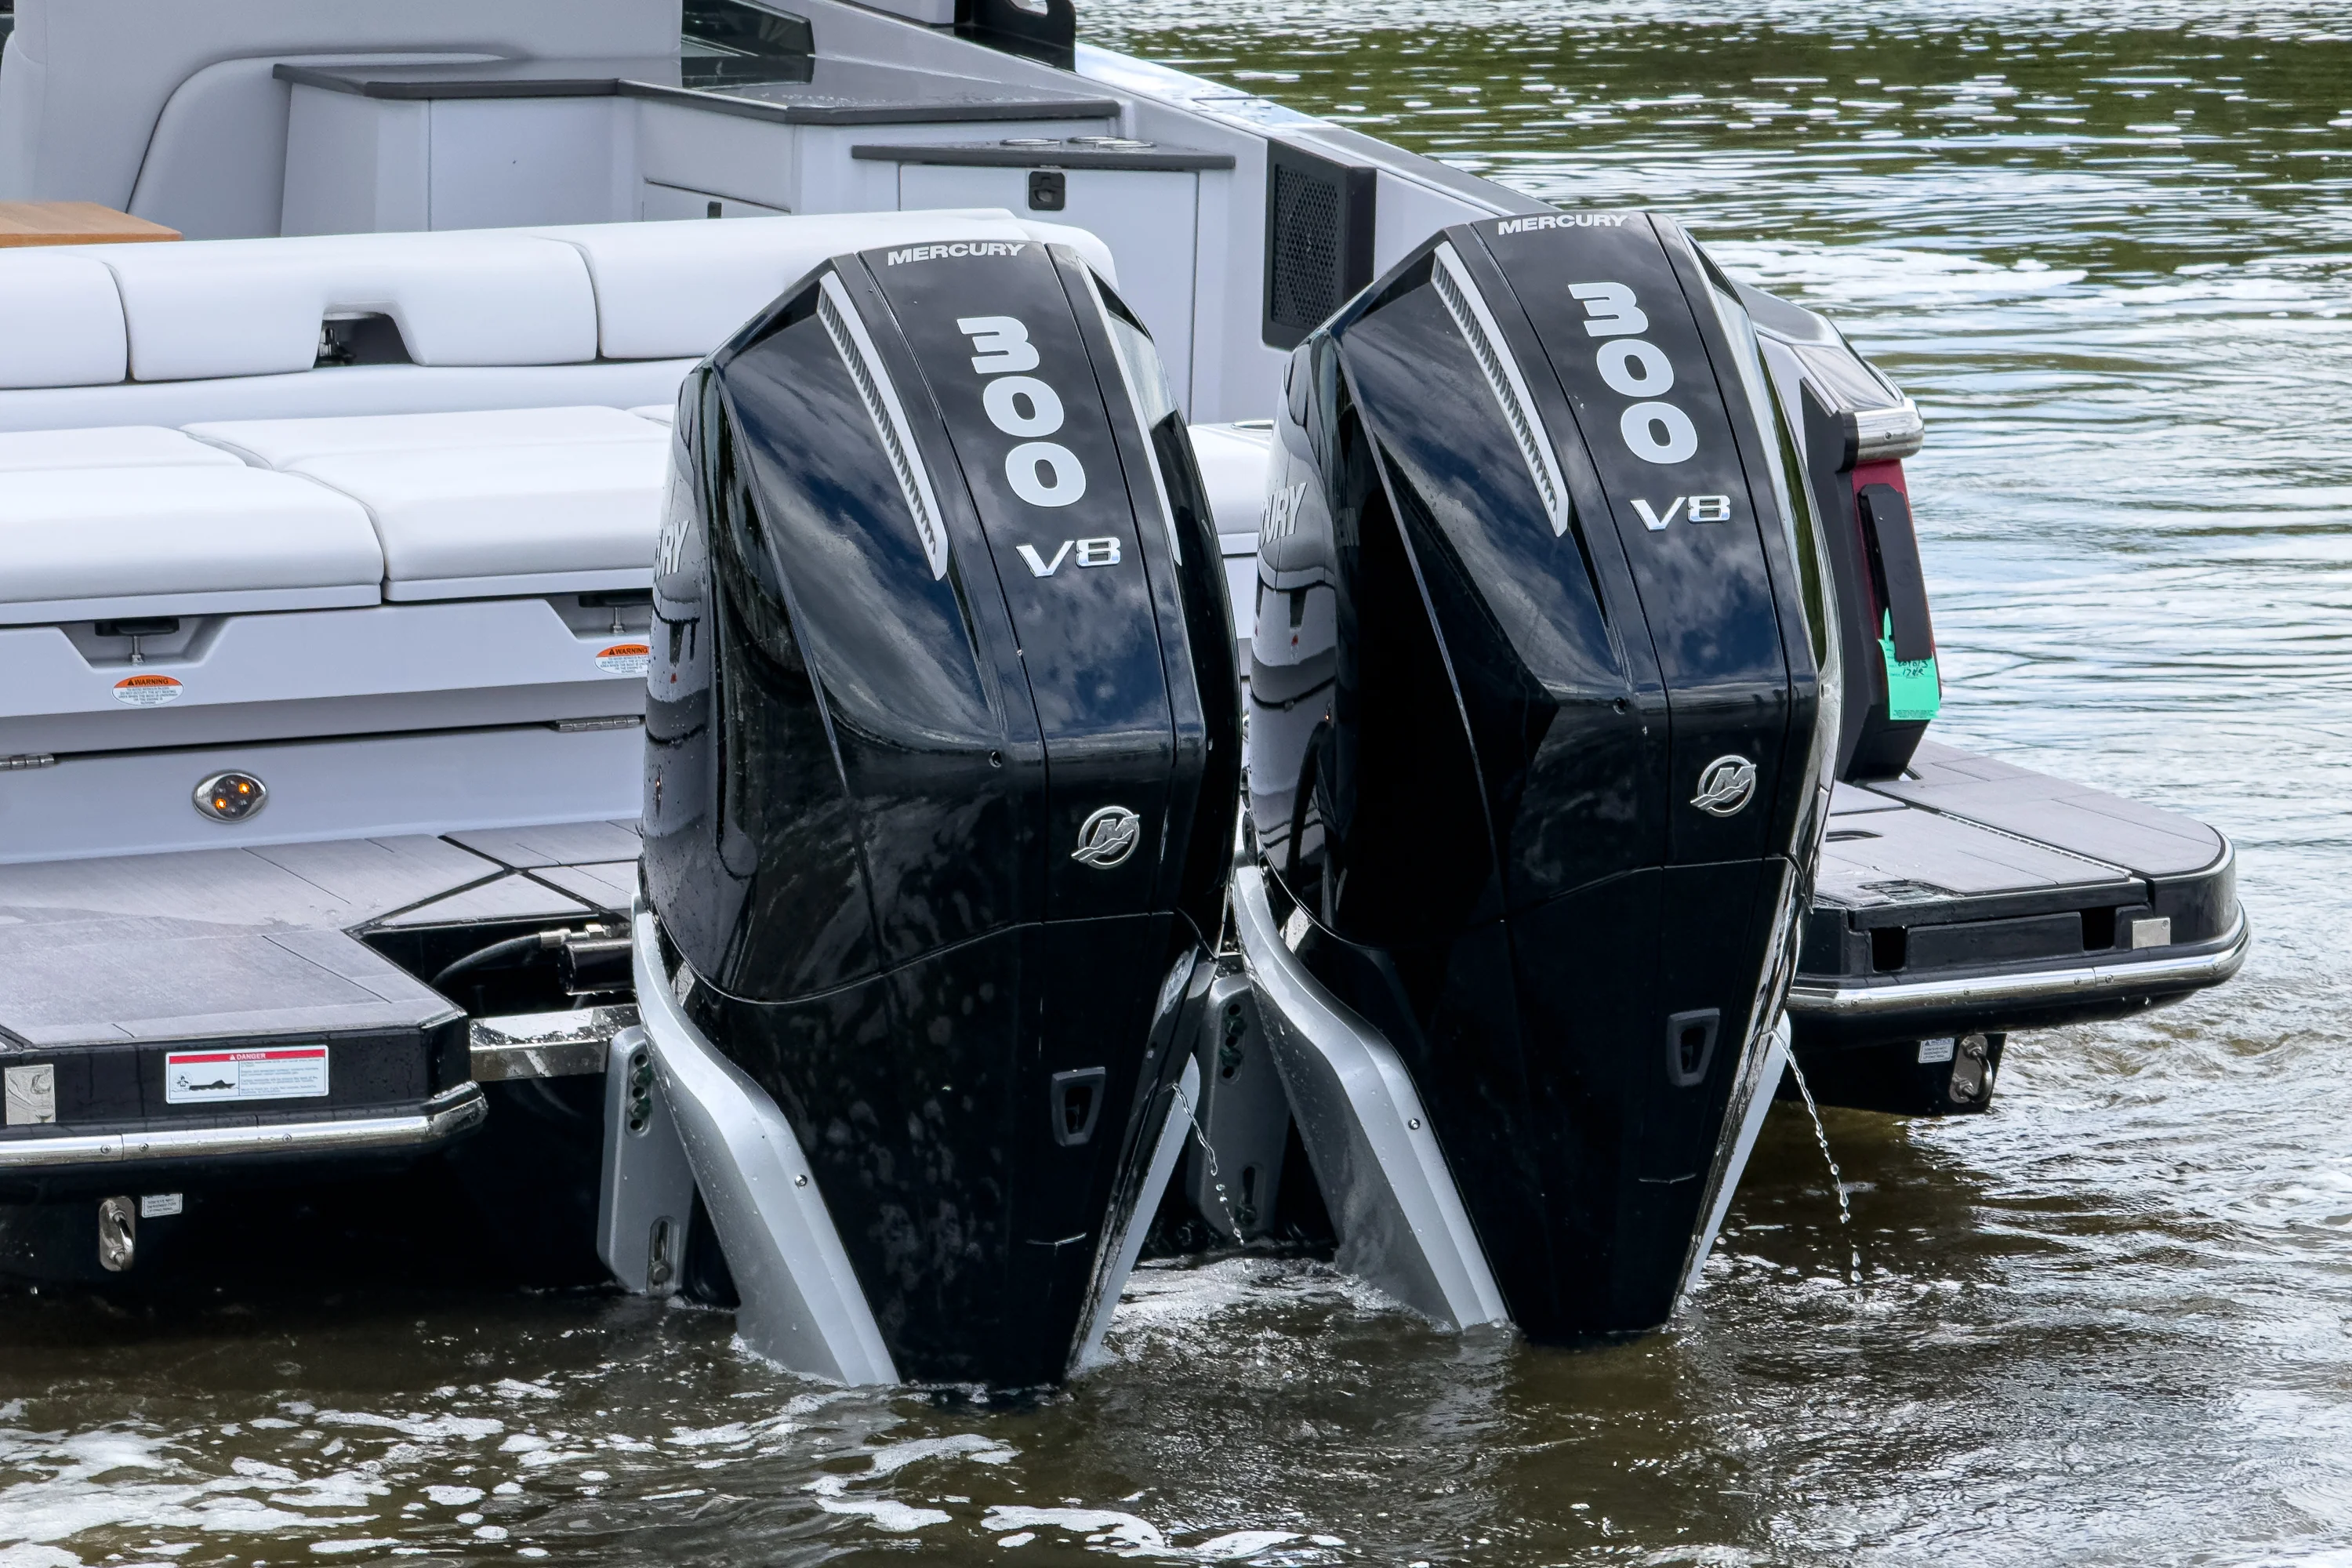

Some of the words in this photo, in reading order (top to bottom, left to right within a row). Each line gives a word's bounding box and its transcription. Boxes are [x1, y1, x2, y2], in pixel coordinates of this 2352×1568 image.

[1498, 214, 1628, 235] MERCURY
[887, 242, 1025, 266] MERCURY
[1568, 281, 1698, 464] 300
[956, 316, 1087, 507] 300
[1630, 495, 1730, 532] V8
[1016, 536, 1121, 578] V8
